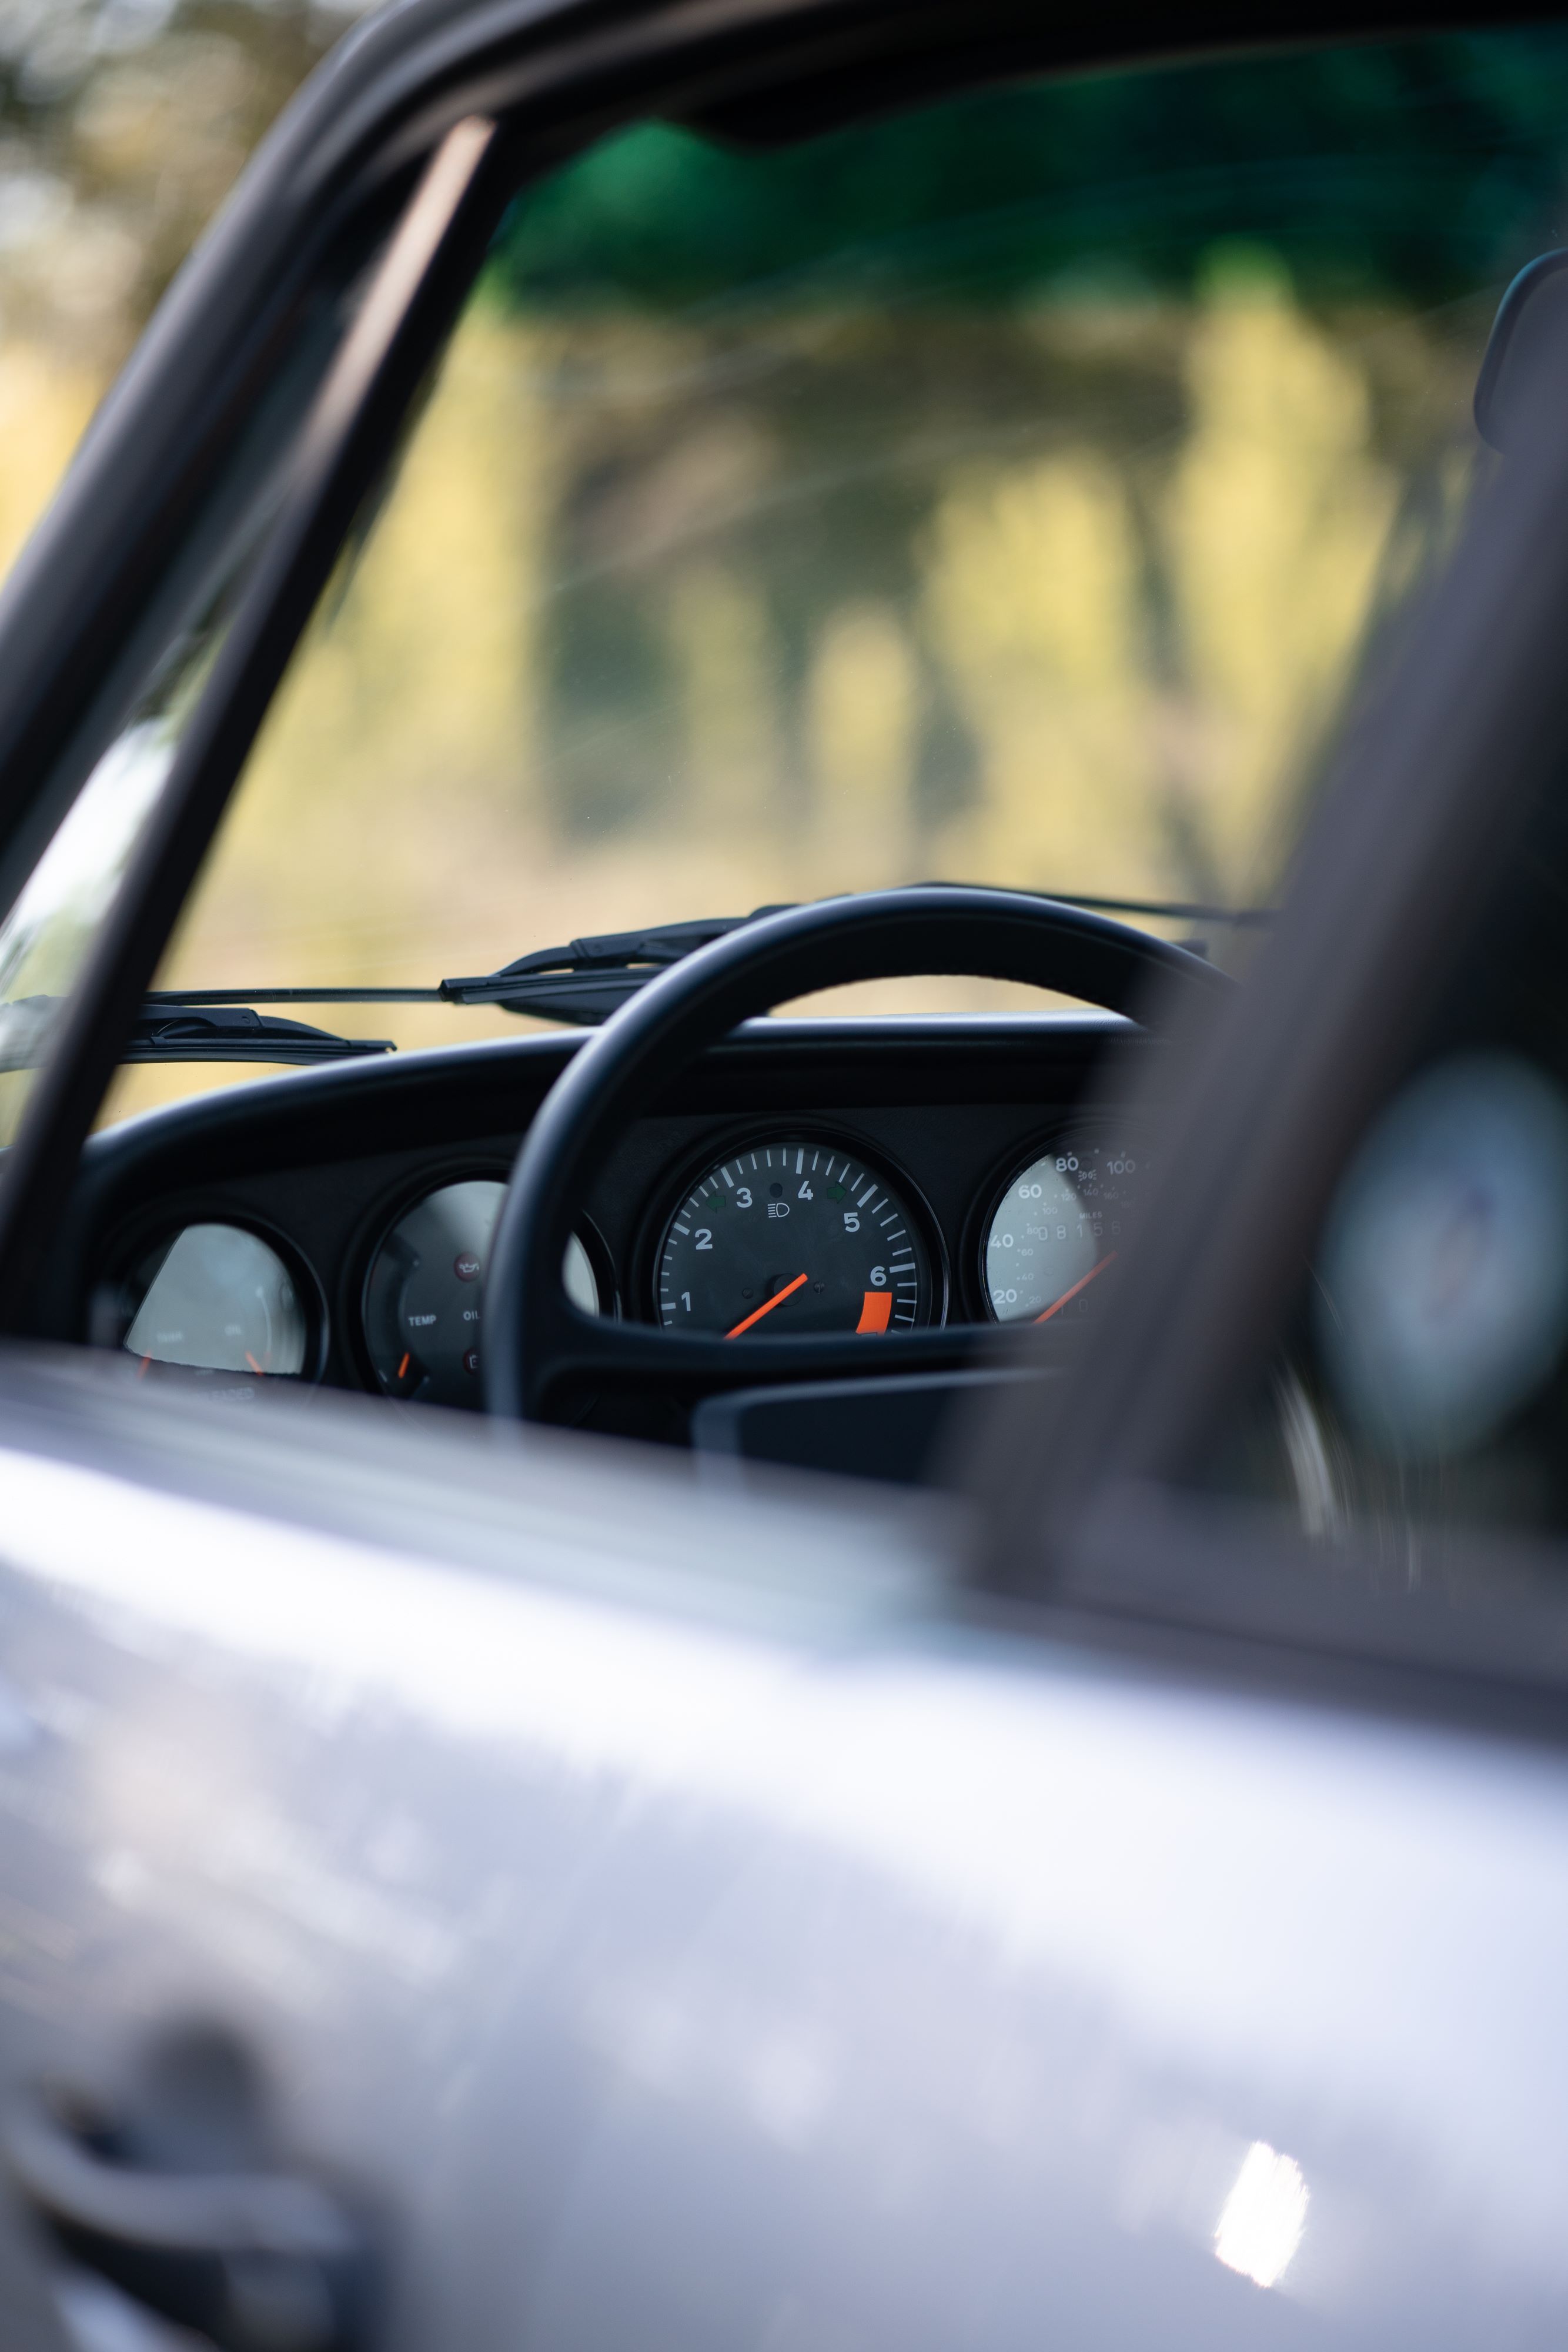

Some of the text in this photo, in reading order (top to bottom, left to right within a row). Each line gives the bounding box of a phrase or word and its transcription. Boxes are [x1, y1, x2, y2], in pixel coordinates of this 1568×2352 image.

[1055, 1156, 1079, 1172] 80
[1106, 1160, 1136, 1175] 100
[736, 1187, 753, 1208] 3
[798, 1180, 814, 1200] 4
[1018, 1184, 1042, 1199] 60
[1061, 1192, 1076, 1201] 120
[1042, 1206, 1058, 1215] 100
[1079, 1211, 1102, 1220] MILES
[844, 1212, 860, 1232] 5
[694, 1228, 713, 1250] 2
[990, 1234, 1014, 1248] 40
[1021, 1247, 1034, 1257] 60
[870, 1266, 887, 1286] 6
[1021, 1272, 1035, 1281] 40
[681, 1291, 691, 1311] 1
[993, 1289, 1018, 1305] 20
[1029, 1295, 1041, 1305] 20
[407, 1313, 437, 1327] TEMP
[463, 1310, 480, 1321] OIL
